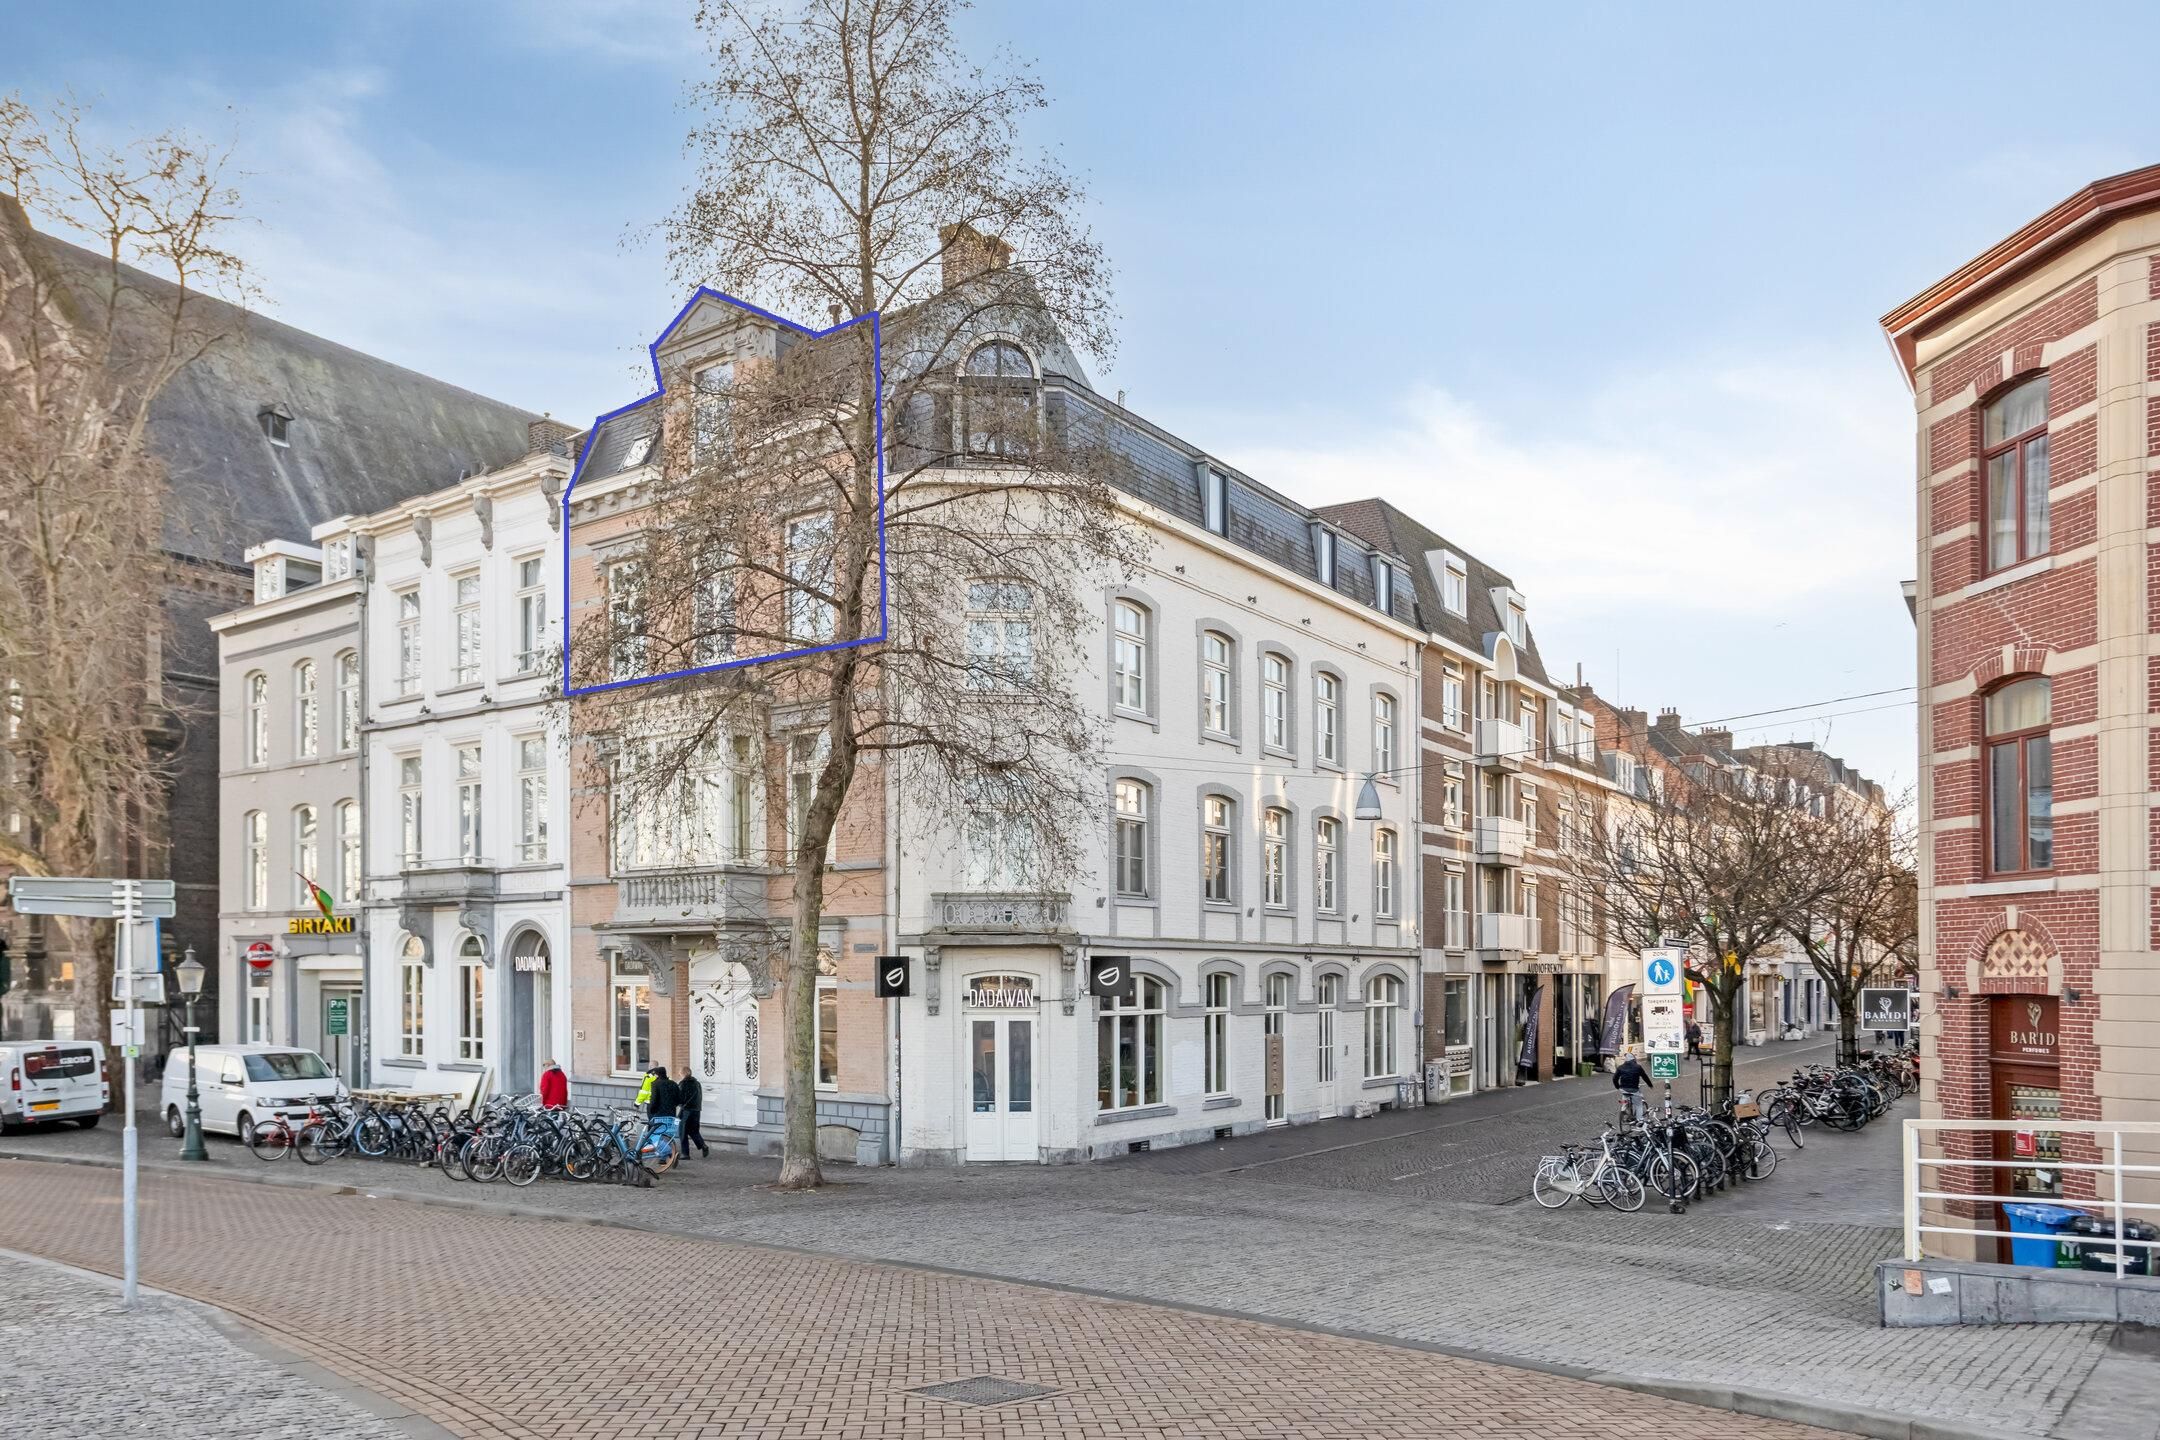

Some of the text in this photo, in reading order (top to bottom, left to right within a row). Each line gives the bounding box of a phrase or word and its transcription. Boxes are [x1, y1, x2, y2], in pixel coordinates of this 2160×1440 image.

[288, 917, 351, 934] SIRTAKI
[515, 956, 546, 971] DADAWAN
[1528, 963, 1563, 974] AUDIOFRENZY
[969, 989, 1034, 1008] DADAWAN
[1864, 1011, 1907, 1020] BARIDI
